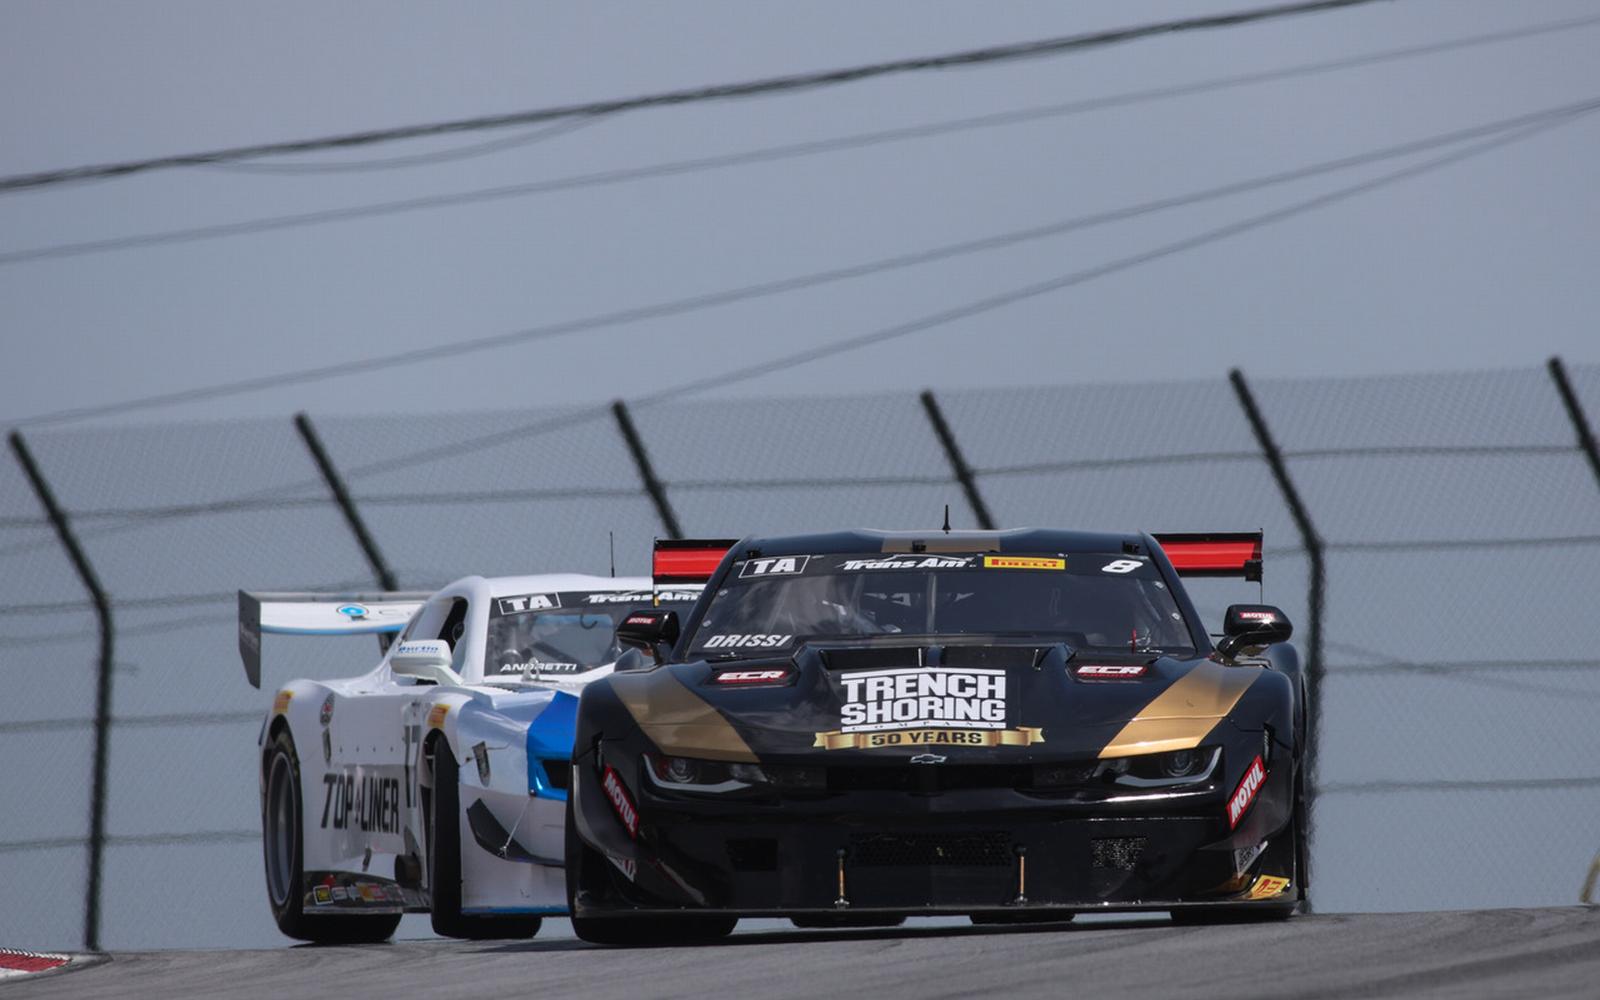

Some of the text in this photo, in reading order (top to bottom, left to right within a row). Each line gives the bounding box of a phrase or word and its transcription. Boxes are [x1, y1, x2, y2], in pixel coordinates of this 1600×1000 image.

[753, 558, 796, 574] TA
[843, 557, 967, 570] Trans Am
[1101, 559, 1144, 574] 8
[506, 594, 553, 611] TA
[589, 594, 653, 604] Trans
[703, 634, 793, 649] DRISSI
[1077, 665, 1144, 674] ECR
[840, 673, 1006, 703] TRENCH
[840, 696, 1006, 726] SHORING
[872, 731, 982, 746] 50 YEARS
[1231, 763, 1264, 824] MOTUL
[320, 772, 400, 835] TOP LINER
[604, 772, 636, 833] MOTUL
